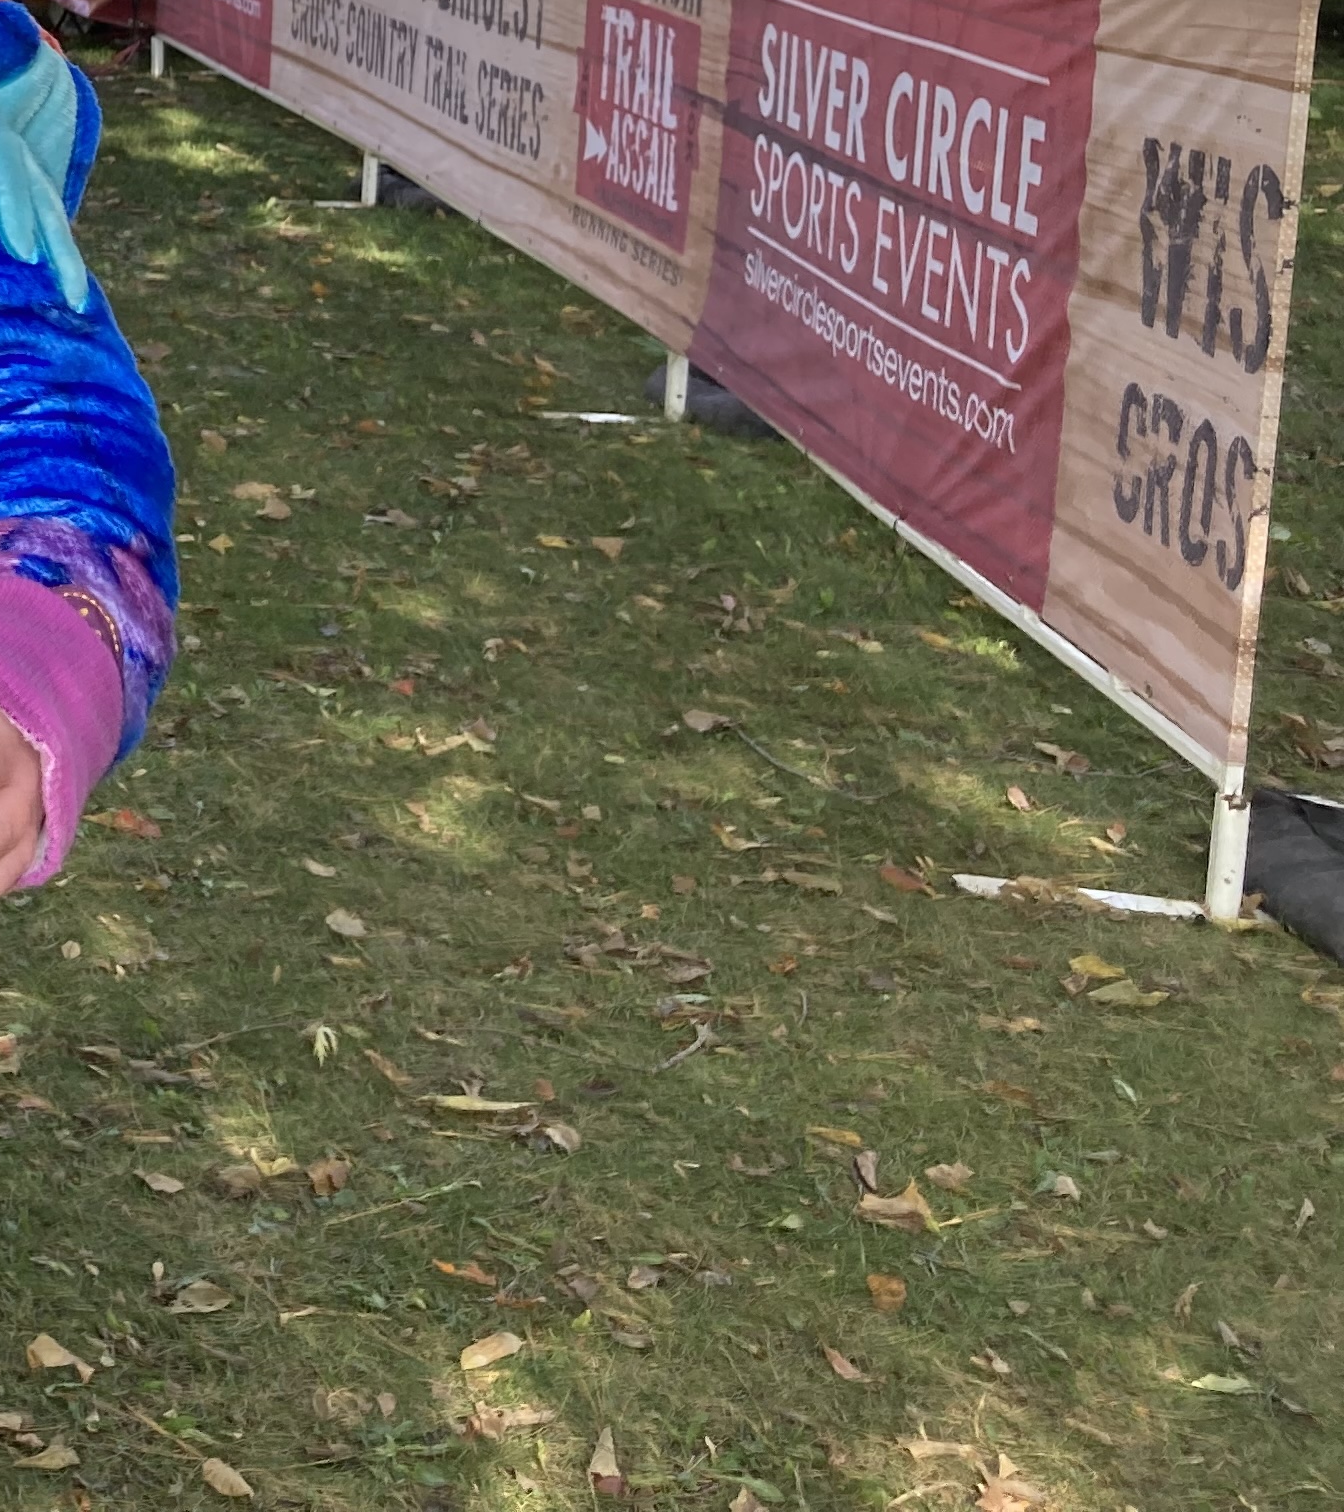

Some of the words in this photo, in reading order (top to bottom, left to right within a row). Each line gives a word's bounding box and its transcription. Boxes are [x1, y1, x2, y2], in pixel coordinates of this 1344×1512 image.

[425, 35, 469, 124] TRAIL
[476, 59, 545, 161] SERIES
[601, 4, 678, 130] TRAIL
[605, 109, 679, 212] ASSAIL
[758, 22, 871, 163] SILVER
[885, 71, 1047, 237] CIRCLE
[744, 249, 1017, 454] silvercirclesportsevents.com
[750, 133, 862, 274] SPORTS
[872, 195, 1032, 364] EVENTS
[1140, 137, 1287, 375] WIS
[1115, 382, 1258, 591] CROS
